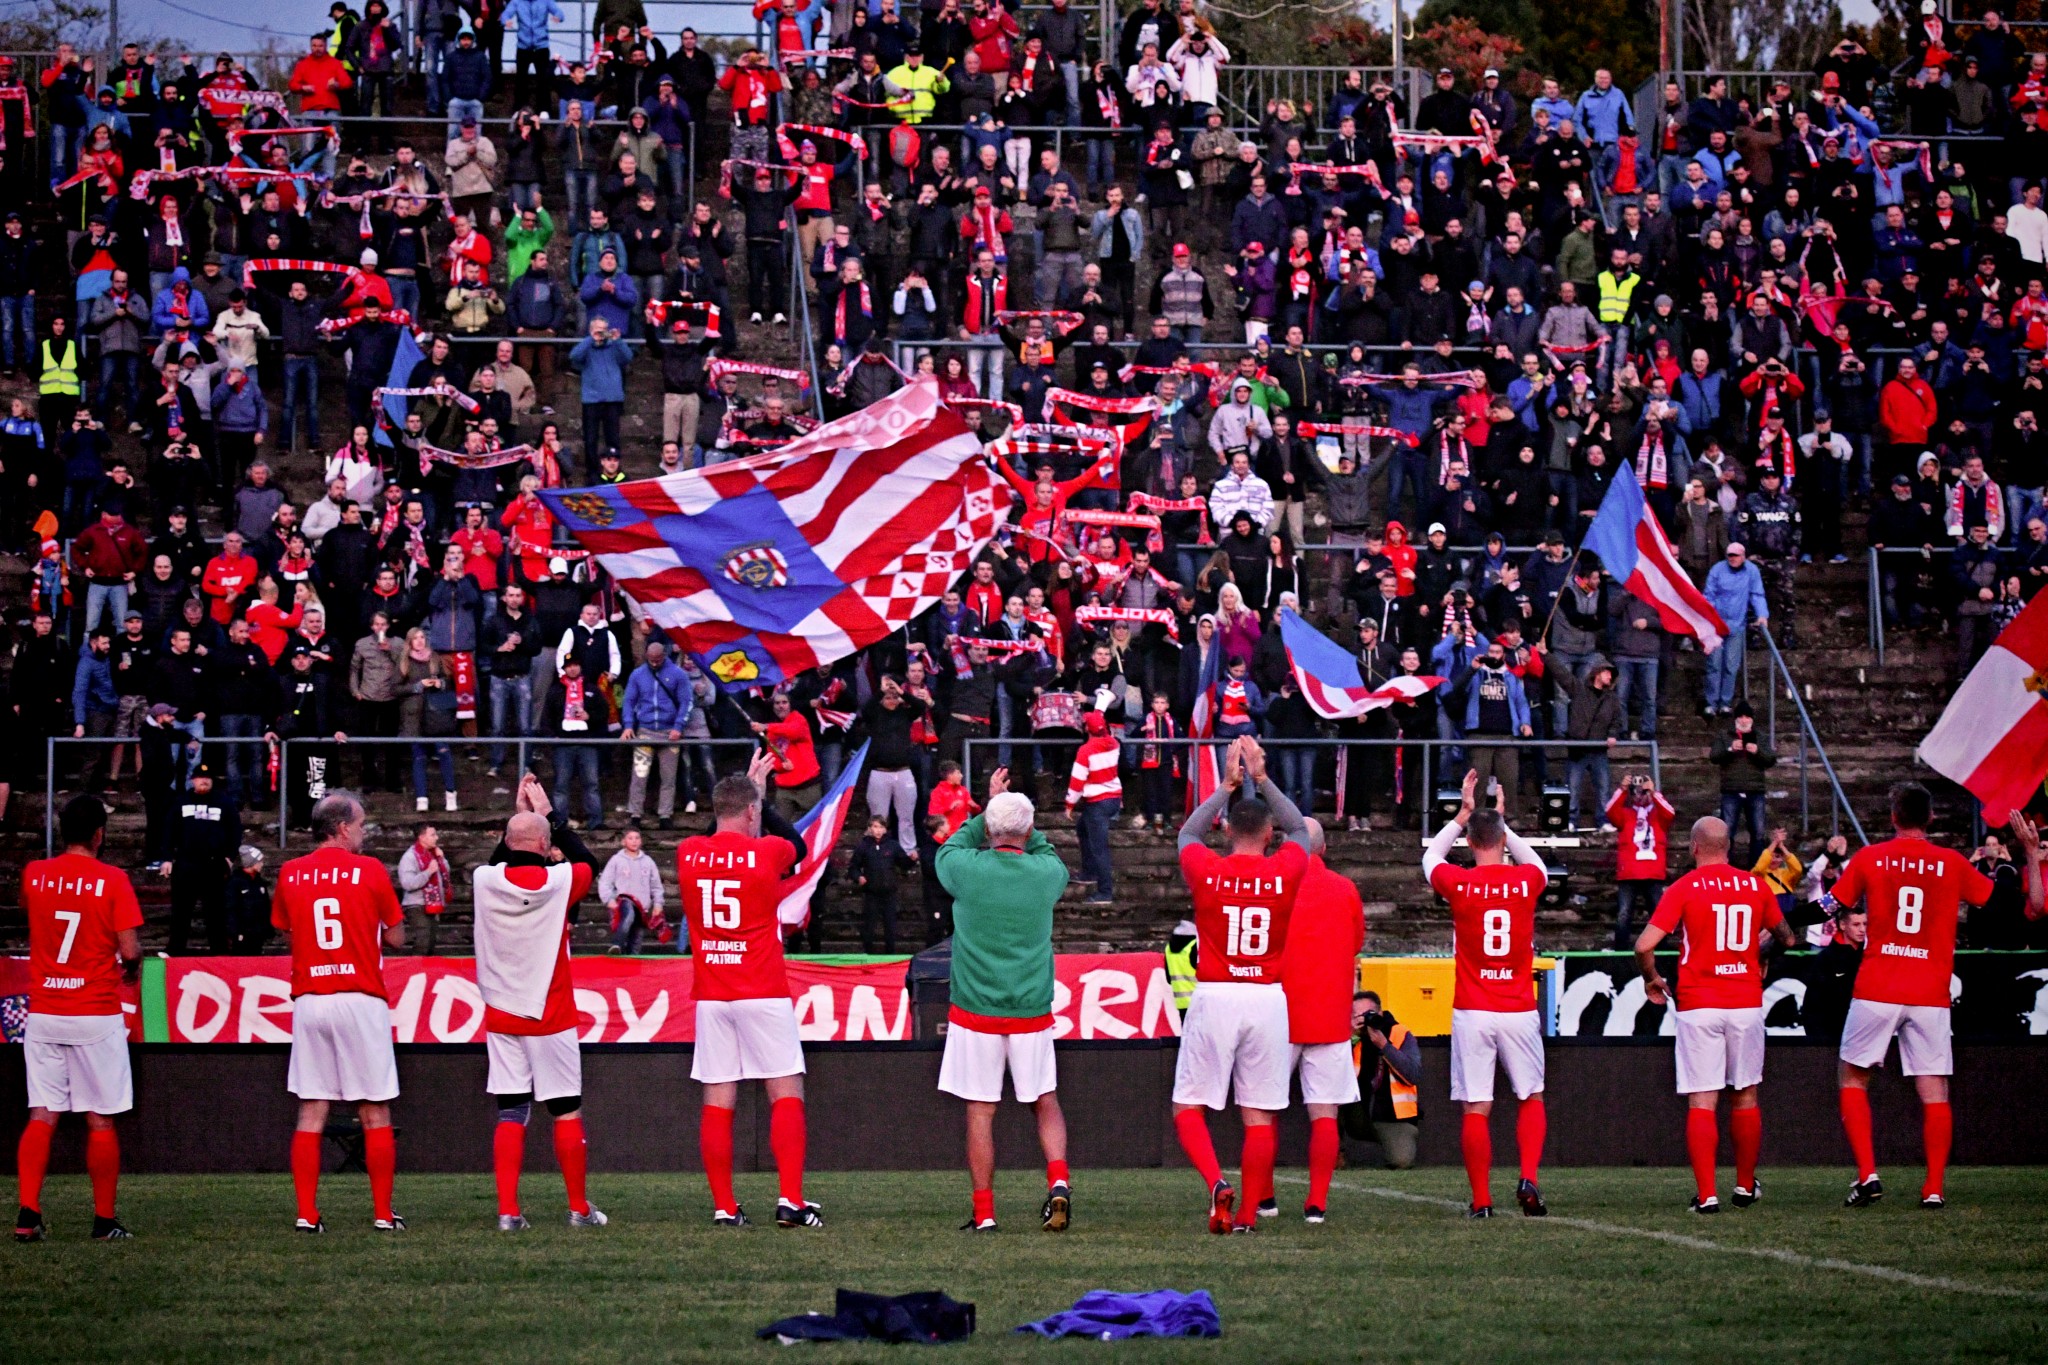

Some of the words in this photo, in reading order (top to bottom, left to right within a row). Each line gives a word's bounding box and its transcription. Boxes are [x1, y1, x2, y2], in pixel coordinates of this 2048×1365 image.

[313, 897, 343, 950] 6
[697, 879, 740, 929] 15
[1712, 904, 1752, 951] 10
[1896, 886, 1924, 934] 8
[54, 911, 81, 964] 7
[1223, 905, 1271, 956] 18
[1483, 909, 1511, 957] 8
[1881, 942, 1928, 959] KŘIVÁNEK
[705, 953, 742, 965] PATRIK
[1480, 967, 1513, 980] POLÁK
[1715, 963, 1748, 975] MEZLÍK
